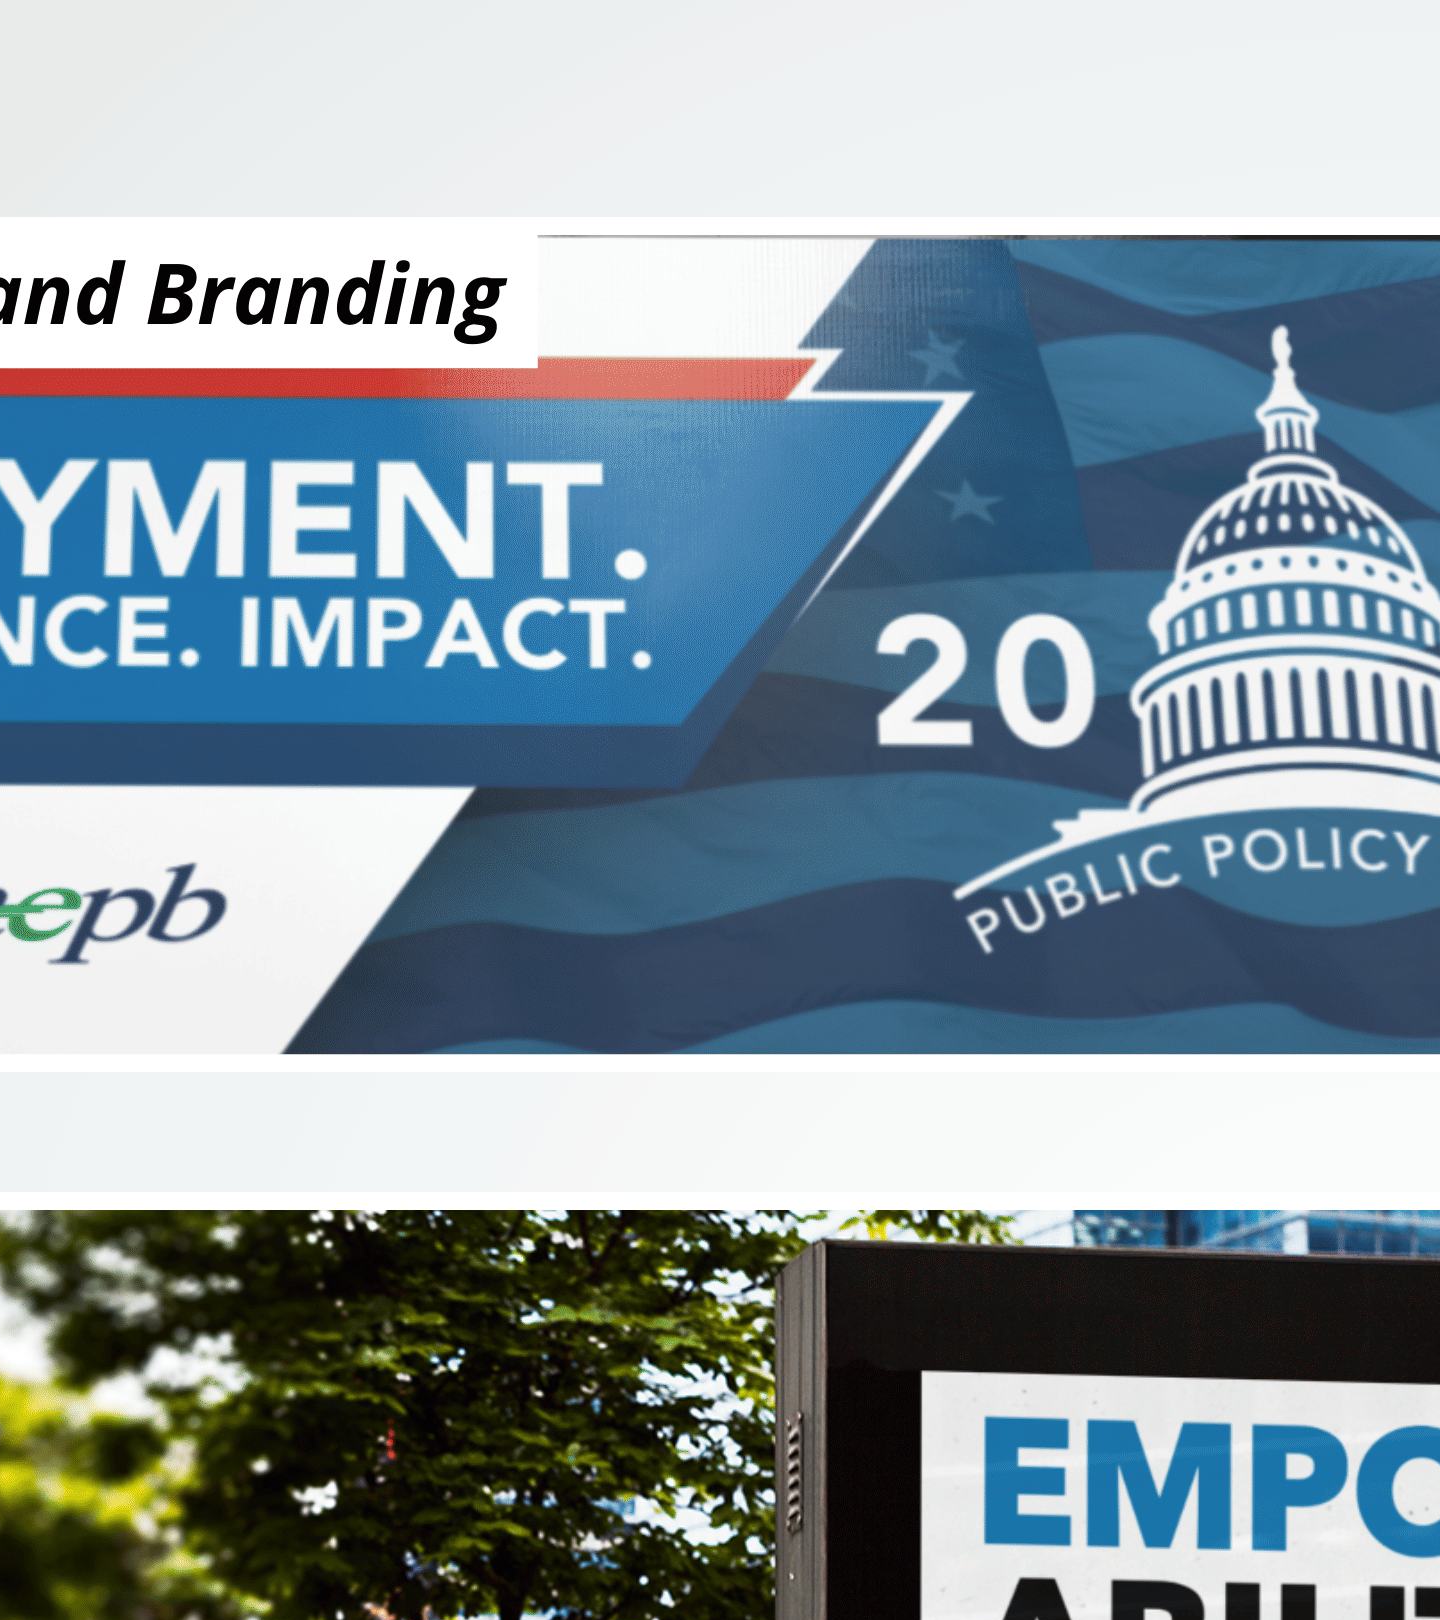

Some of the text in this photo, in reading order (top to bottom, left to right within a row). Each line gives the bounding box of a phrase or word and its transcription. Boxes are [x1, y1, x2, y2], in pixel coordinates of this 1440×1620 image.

[241, 597, 651, 671] IMPACT.
[877, 613, 1095, 748] 20
[967, 843, 1180, 953] PUBLIC
[1203, 828, 1430, 877] POLICY
